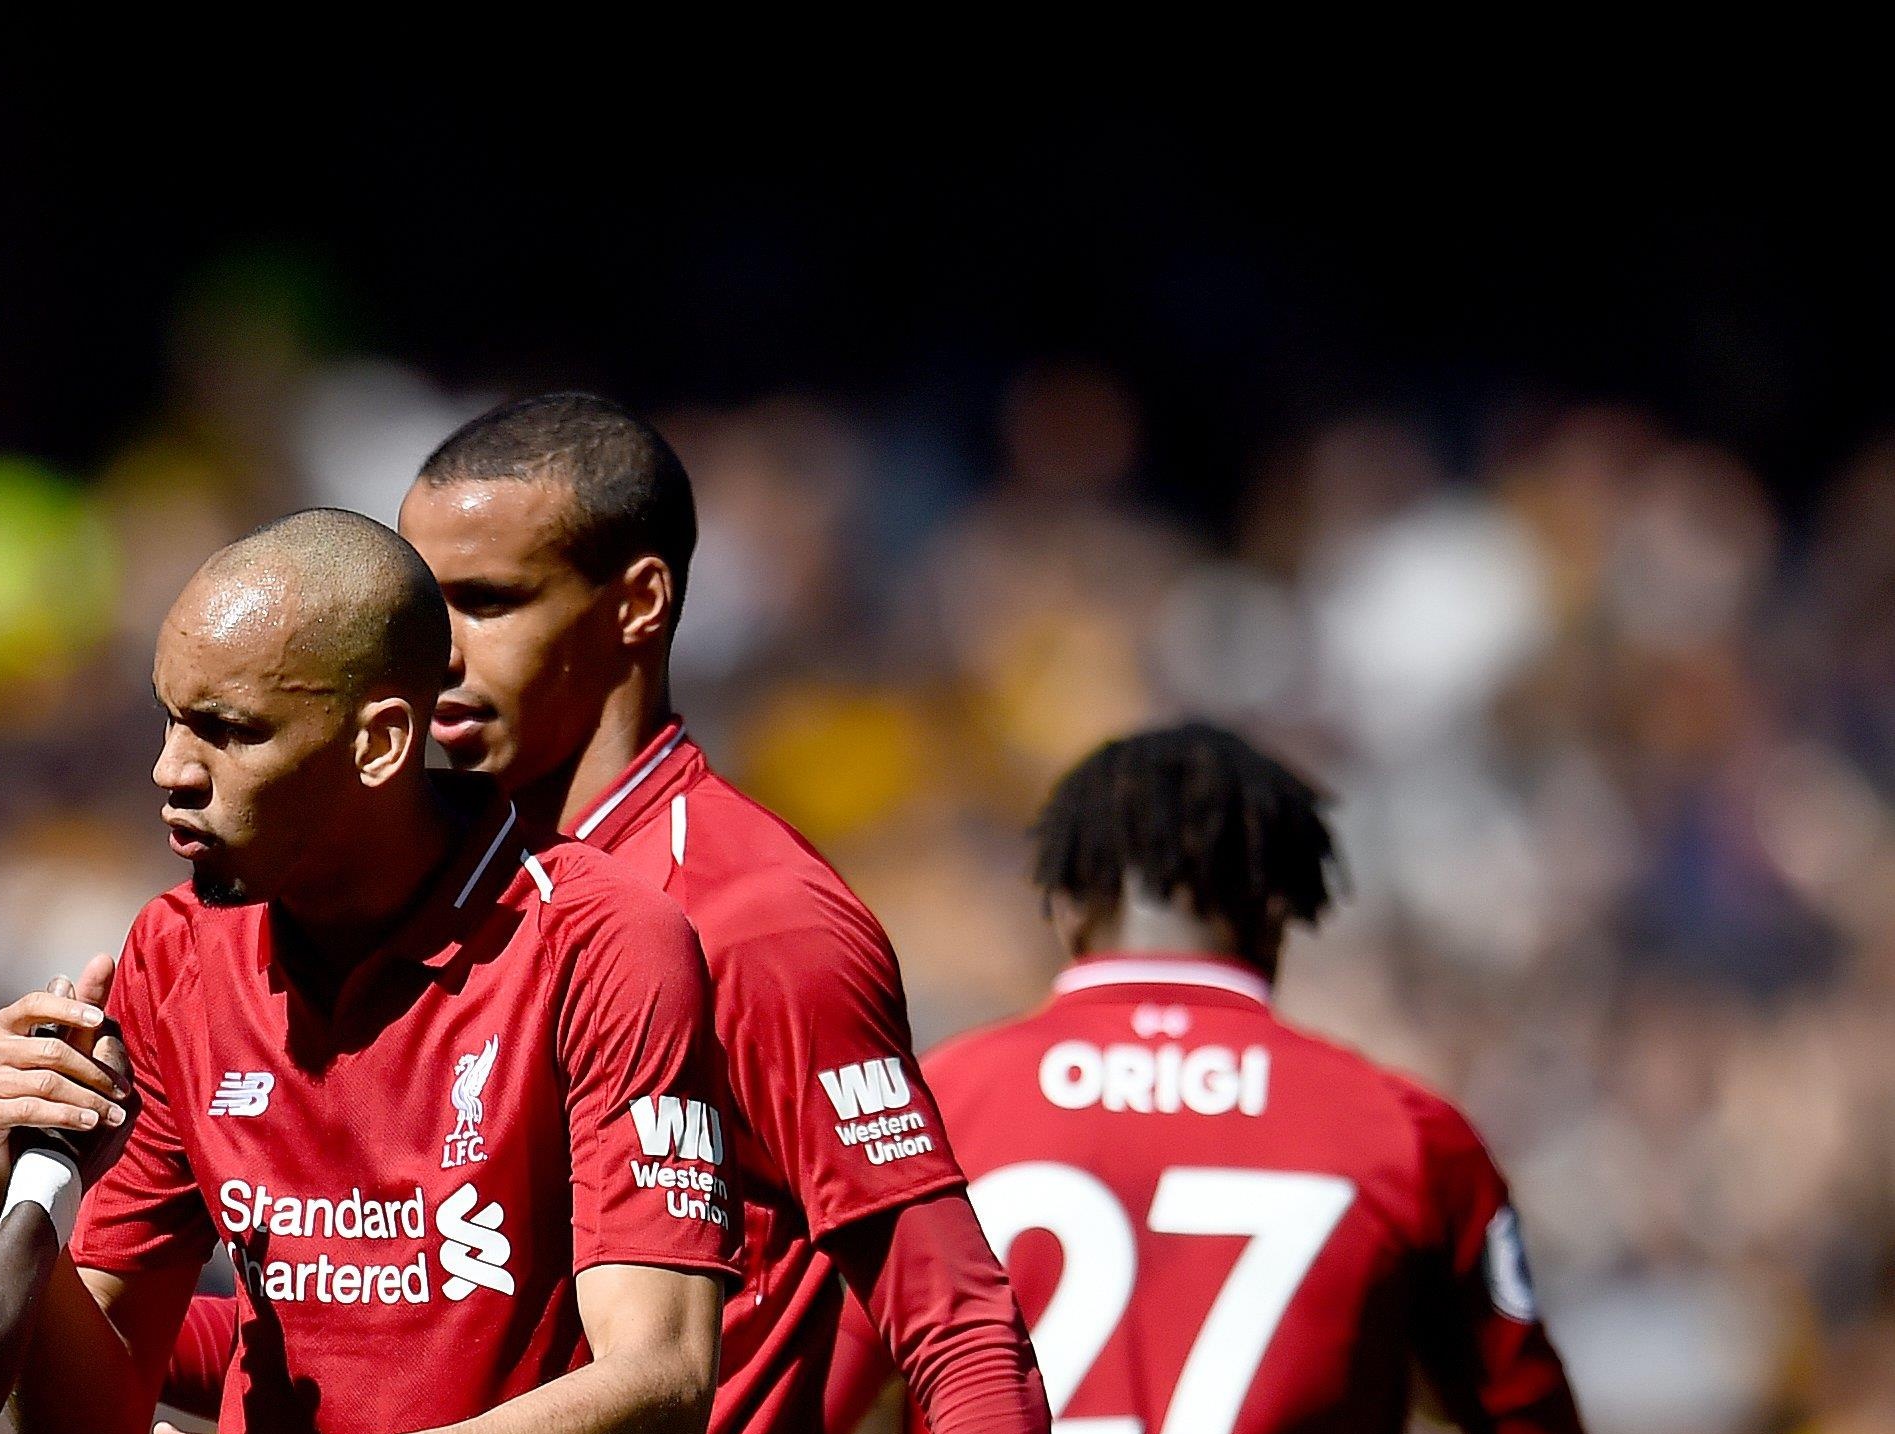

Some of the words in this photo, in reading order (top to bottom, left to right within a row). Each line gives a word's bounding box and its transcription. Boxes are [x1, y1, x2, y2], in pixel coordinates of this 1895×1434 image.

[817, 1057, 911, 1121] WU
[1039, 1040, 1270, 1118] ORIGI
[834, 1112, 925, 1147] Western
[864, 1134, 934, 1166] Union
[630, 1160, 728, 1201] Western
[219, 1178, 426, 1240] Standard
[666, 1190, 729, 1231] Union
[226, 1240, 431, 1304] hartered
